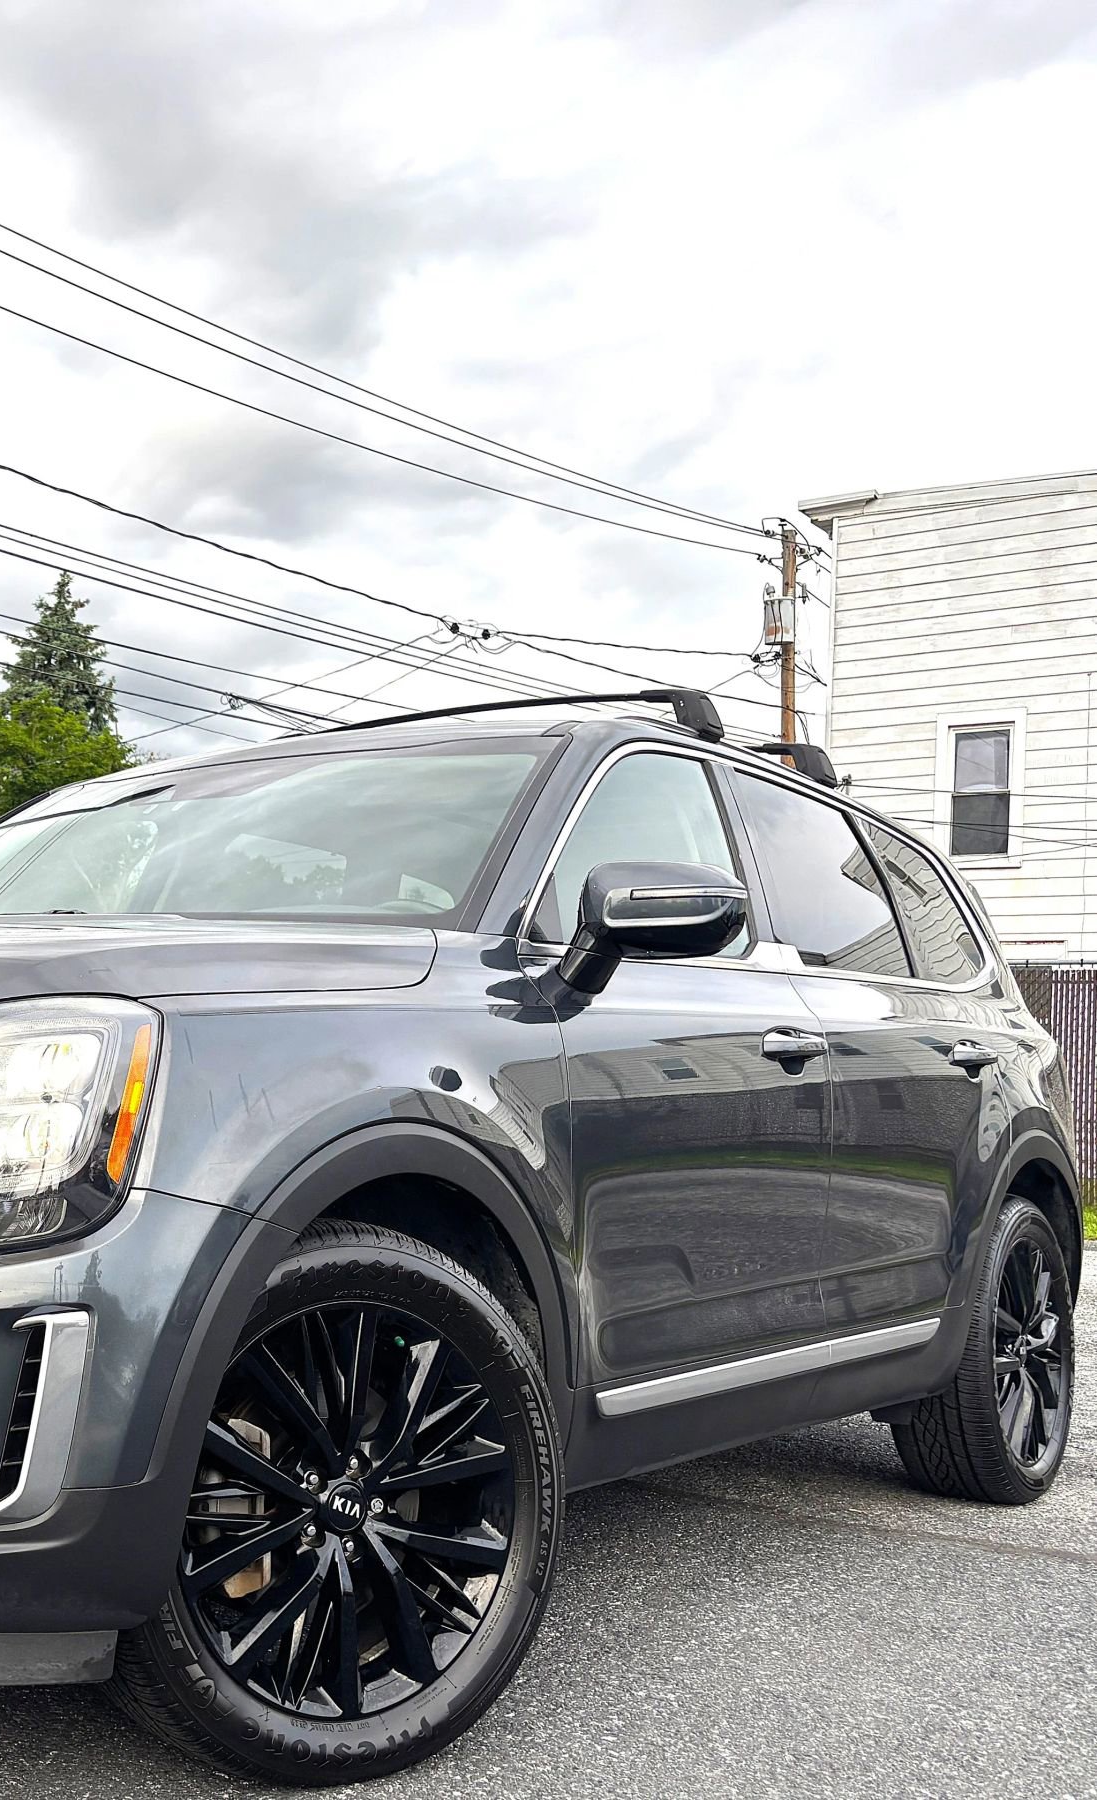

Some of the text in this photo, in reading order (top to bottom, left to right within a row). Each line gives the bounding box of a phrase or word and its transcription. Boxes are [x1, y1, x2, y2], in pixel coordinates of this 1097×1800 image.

[279, 1258, 474, 1319] Firestone
[519, 1383, 551, 1536] FIREHAWK
[332, 1495, 361, 1519] KIA
[538, 1540, 549, 1556] AS
[534, 1562, 545, 1576] V2
[239, 1715, 433, 1770] Firestone
